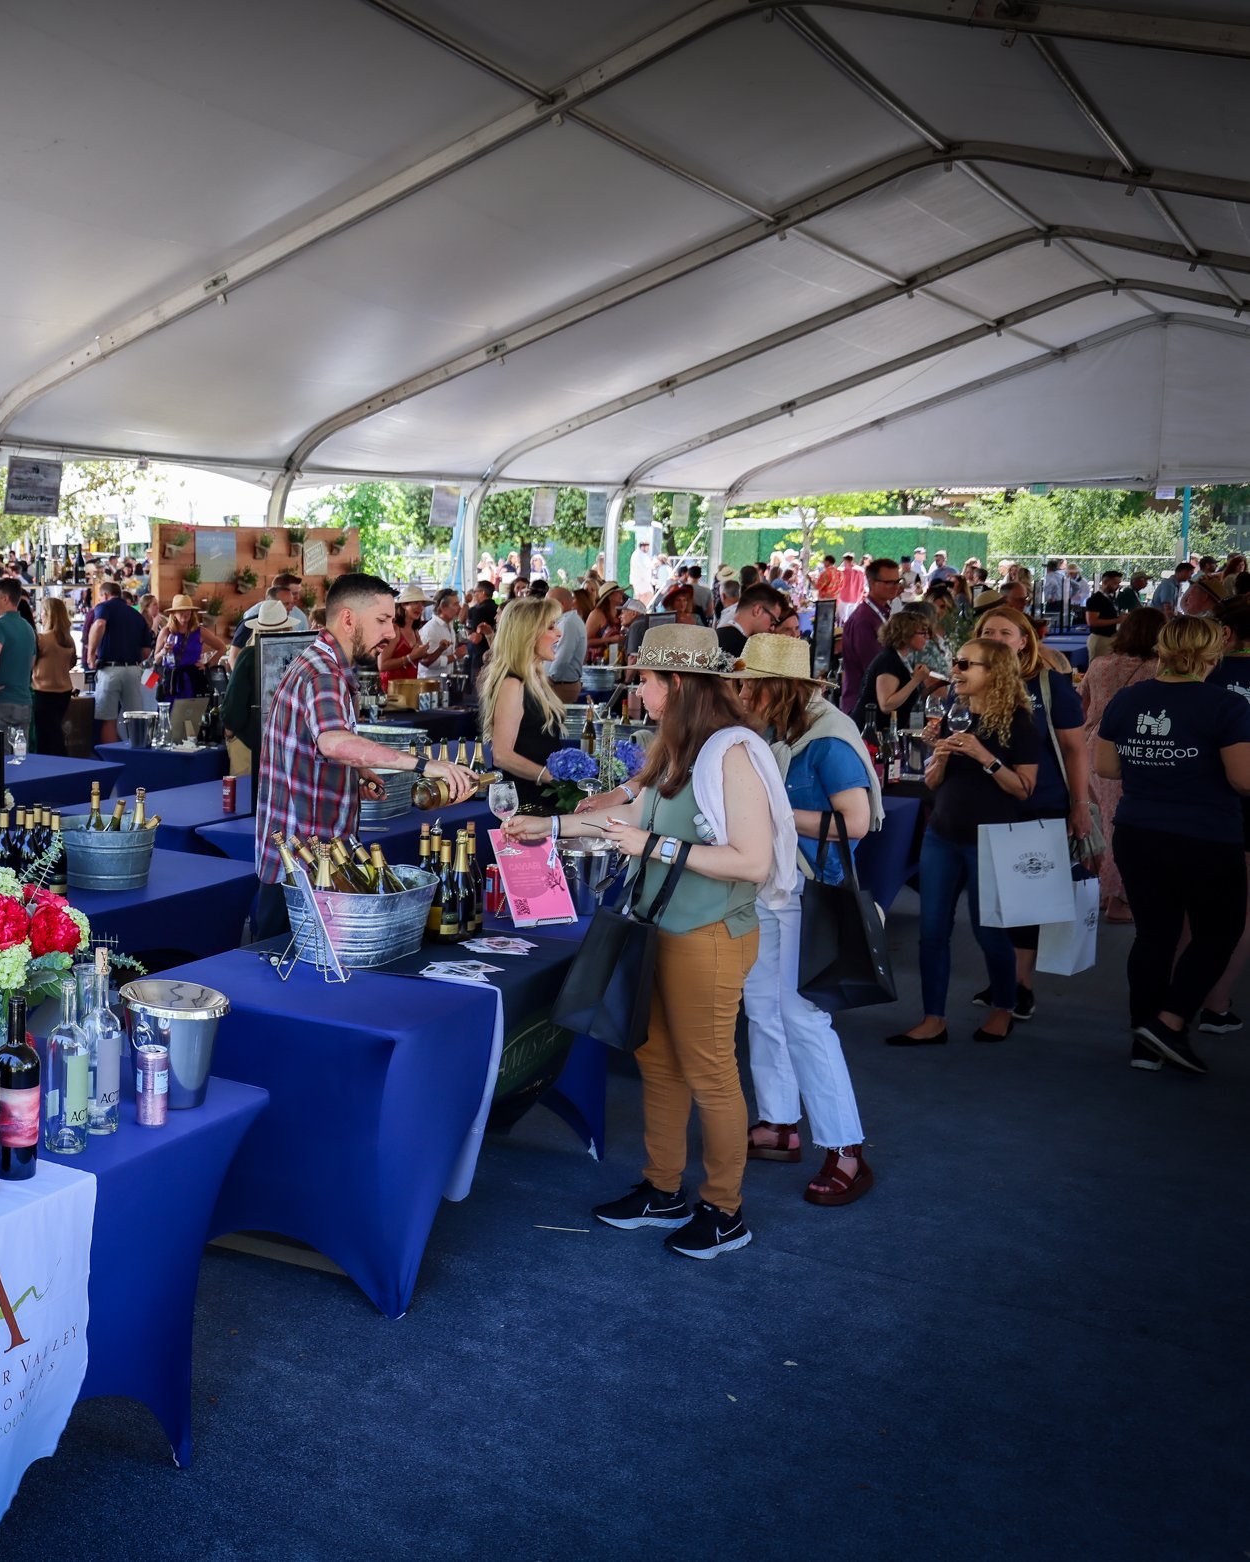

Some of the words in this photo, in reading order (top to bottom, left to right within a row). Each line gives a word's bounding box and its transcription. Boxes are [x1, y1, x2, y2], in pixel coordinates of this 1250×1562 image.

[1127, 738, 1175, 746] HEALDSBURG
[1116, 744, 1143, 758] WINE
[1145, 747, 1154, 758] &
[1155, 747, 1199, 759] FOOD
[20, 1324, 78, 1373] VALLEY
